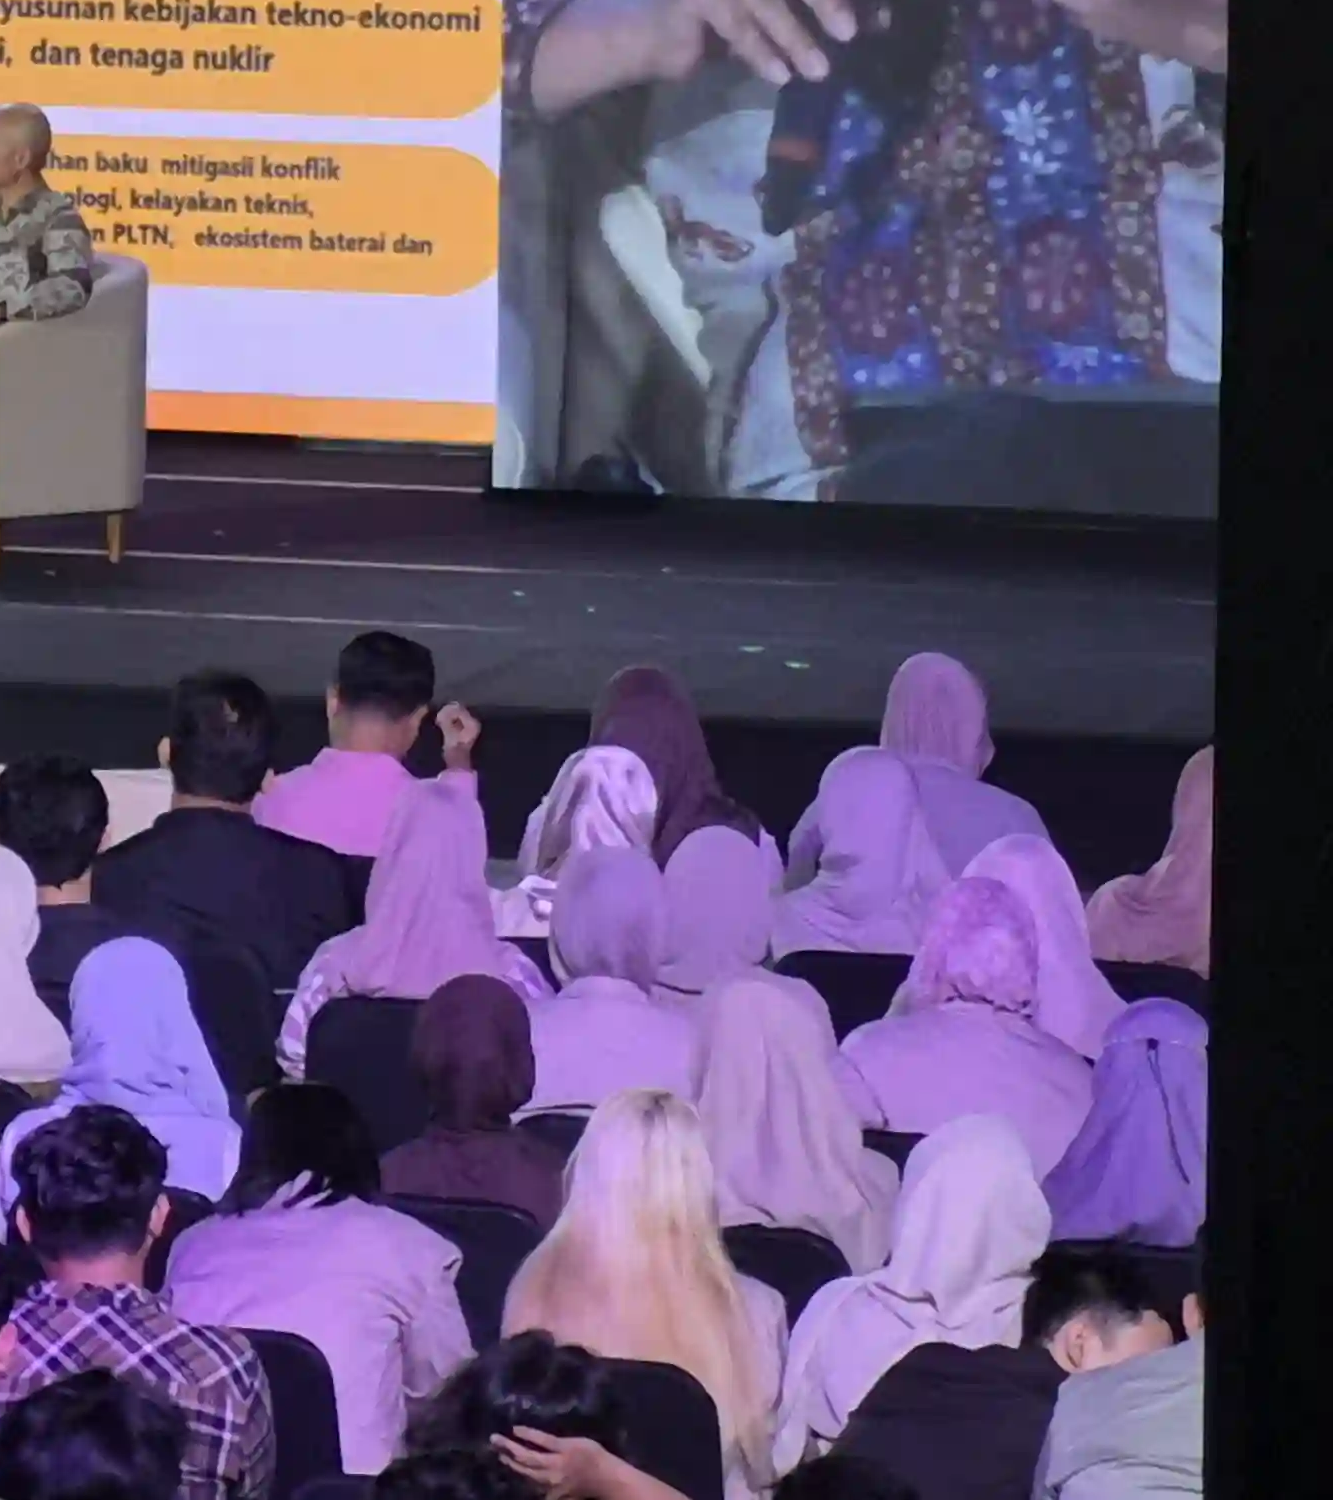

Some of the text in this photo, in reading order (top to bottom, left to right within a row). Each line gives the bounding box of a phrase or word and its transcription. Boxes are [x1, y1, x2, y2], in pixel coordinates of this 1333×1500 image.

[266, 1, 480, 33] tekno-ekonomi
[30, 39, 81, 66] dan
[90, 43, 185, 75] tenaga
[193, 44, 275, 73] nuklir
[96, 152, 148, 173] baku
[261, 156, 339, 181] konflik
[130, 188, 236, 216] kelayakan
[245, 193, 314, 218] teknis,
[113, 224, 174, 248] PLTN,
[194, 226, 302, 250] ekosistem
[310, 228, 385, 253] baterai
[393, 234, 433, 257] dan
